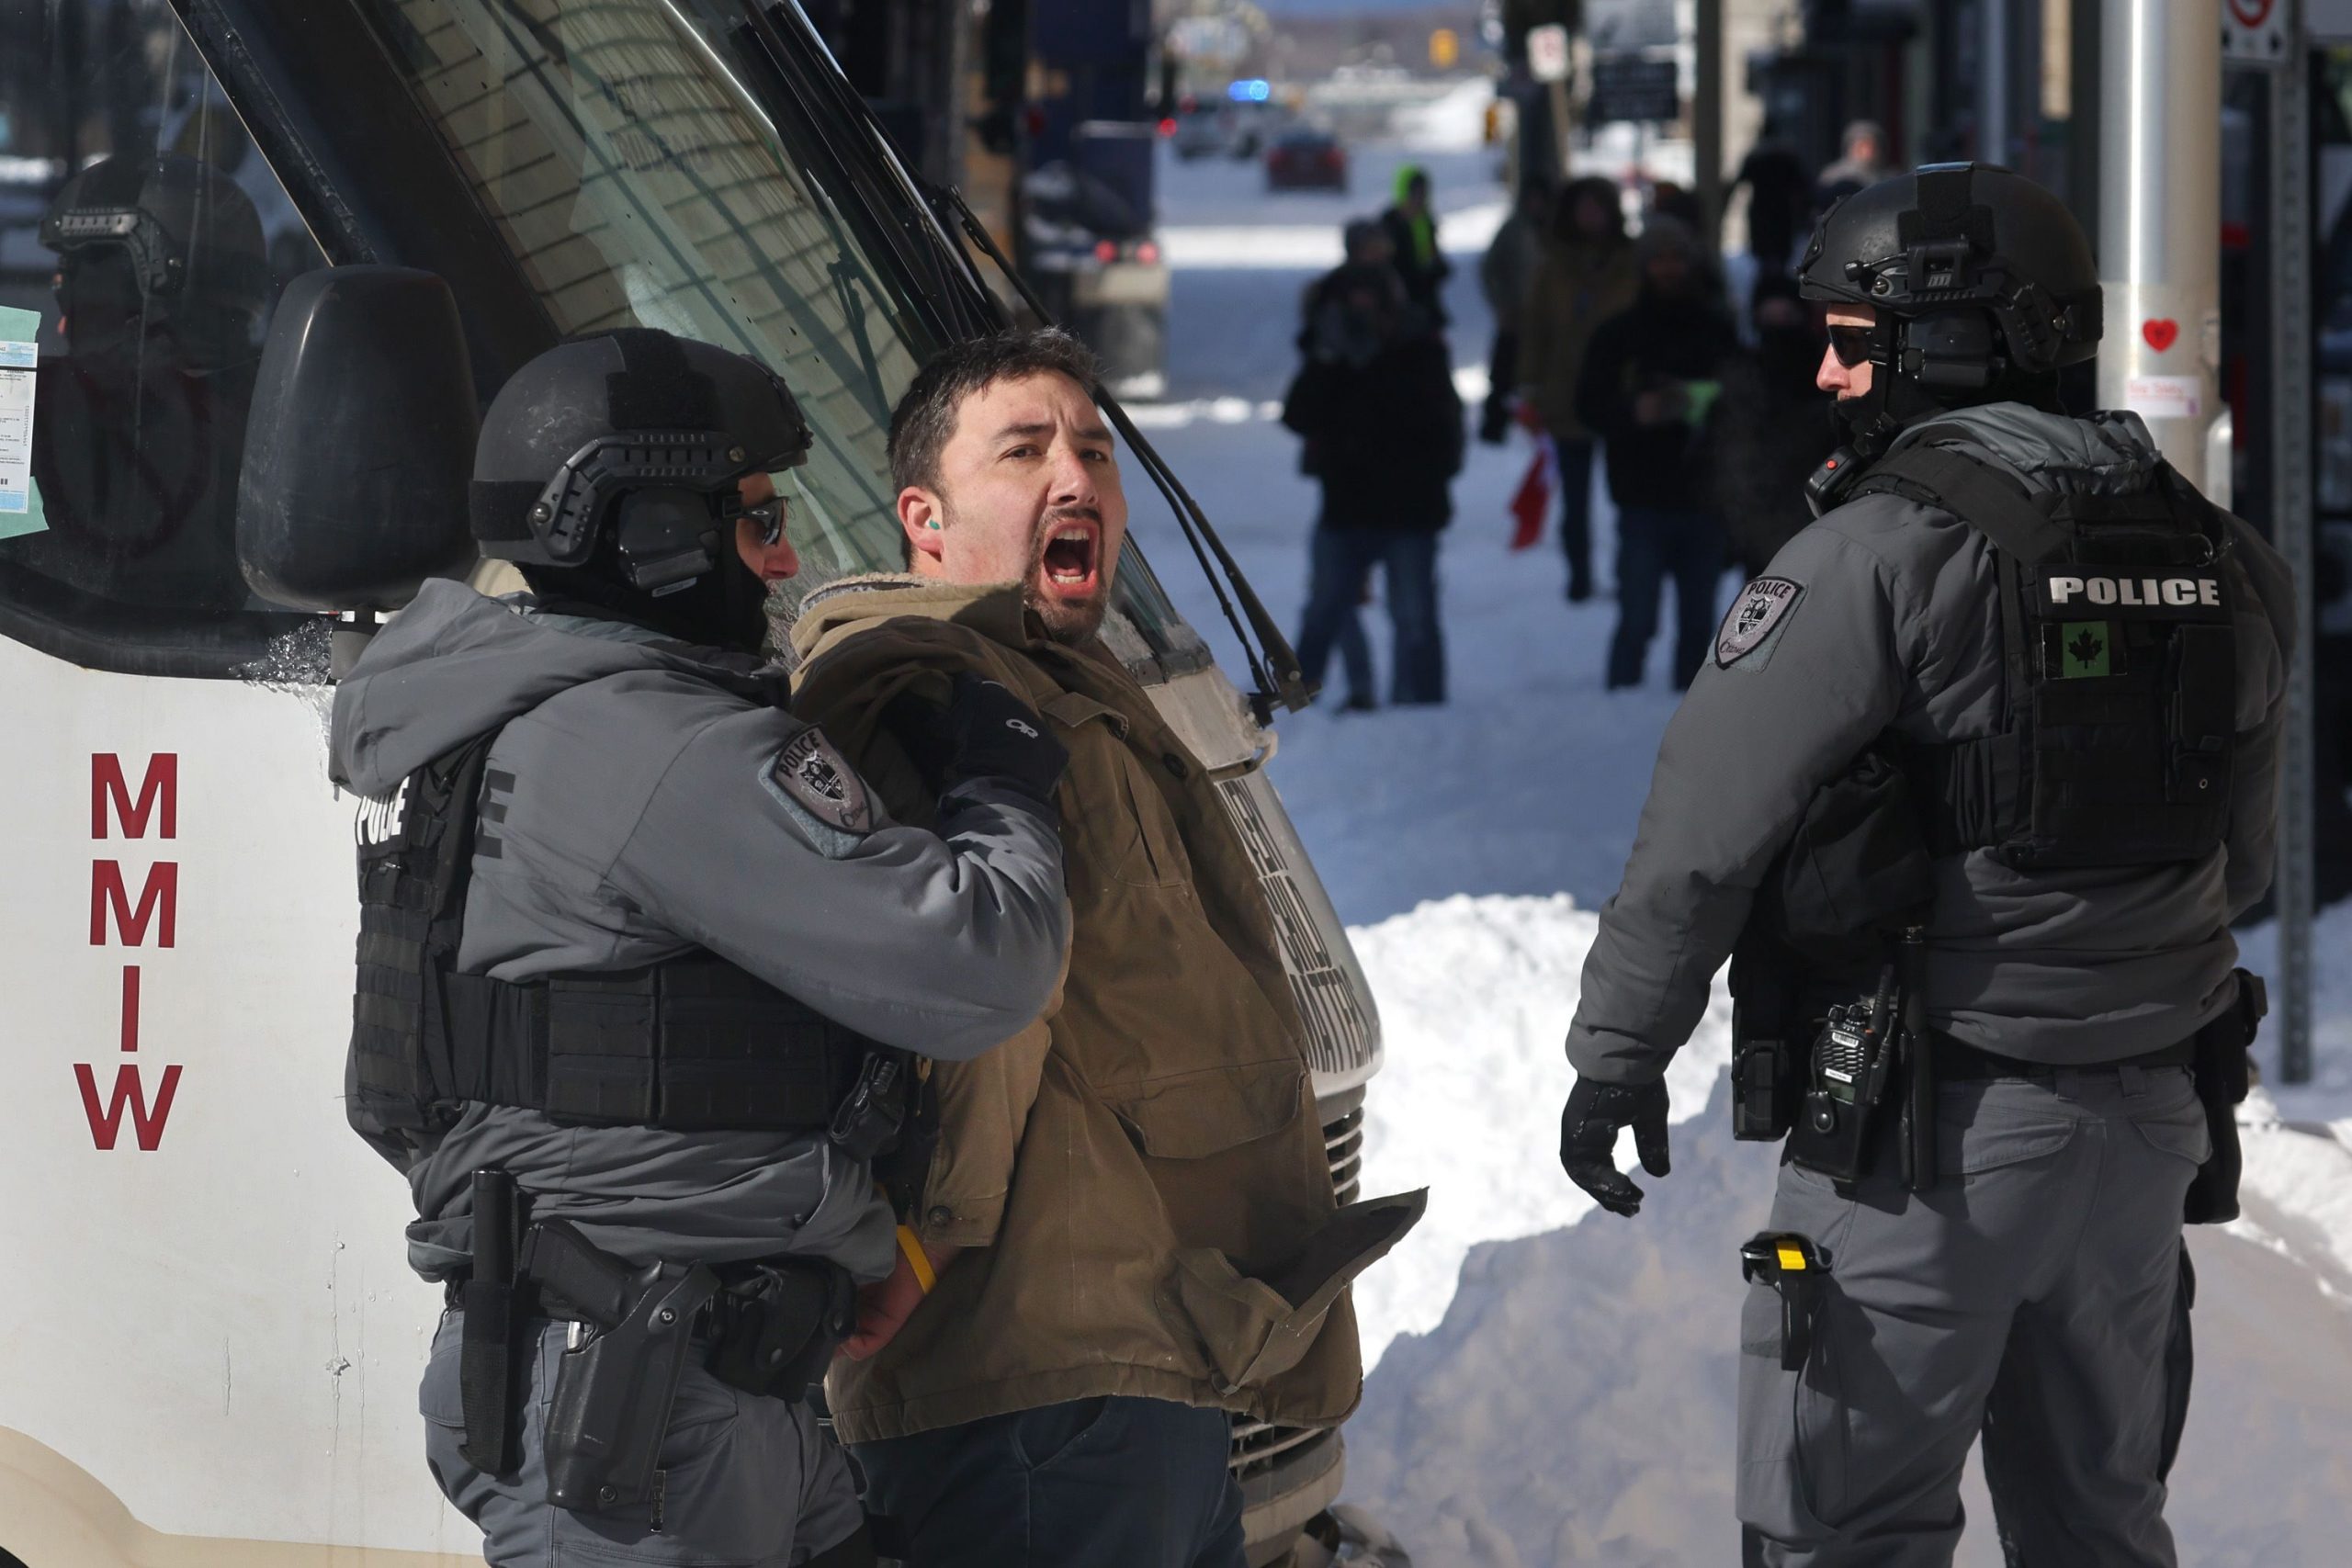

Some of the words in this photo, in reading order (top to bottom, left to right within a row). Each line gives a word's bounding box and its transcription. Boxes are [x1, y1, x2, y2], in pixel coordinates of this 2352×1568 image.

[1747, 581, 1792, 599] POLICE
[2049, 577, 2220, 606] POLICE
[778, 731, 820, 779] POLICE
